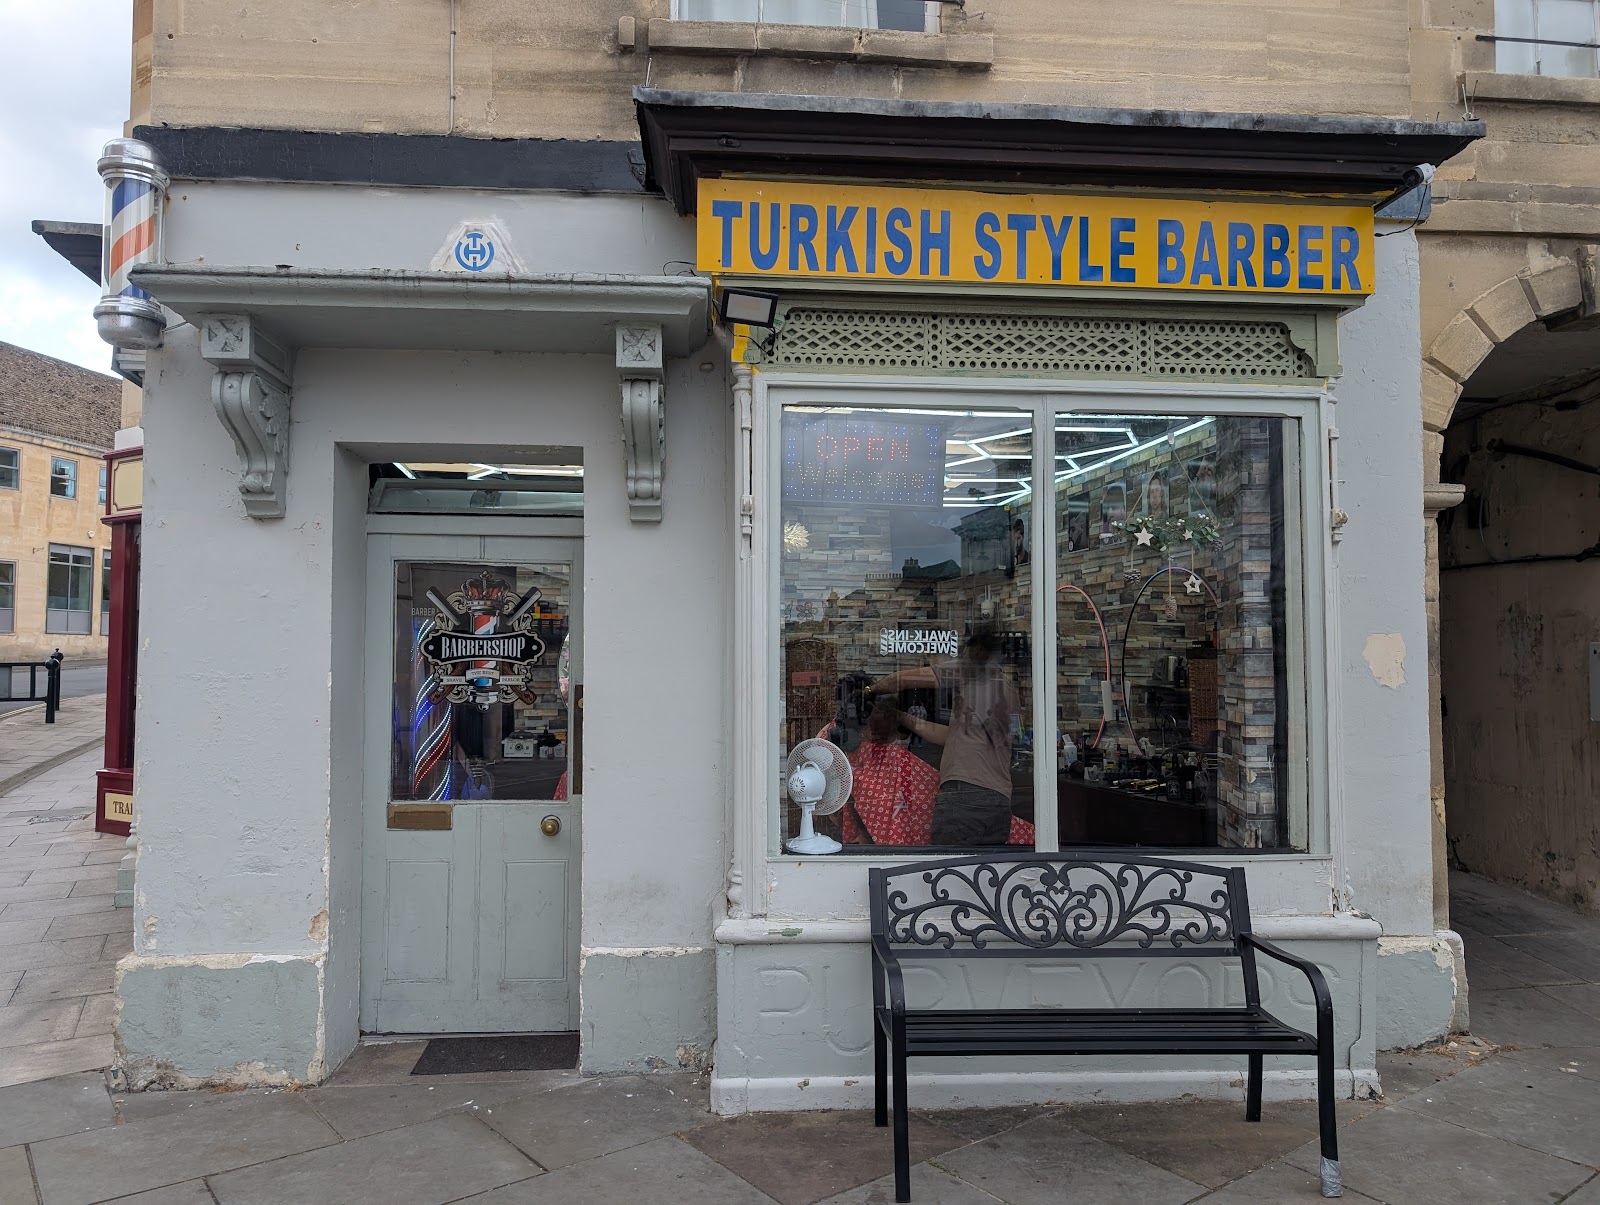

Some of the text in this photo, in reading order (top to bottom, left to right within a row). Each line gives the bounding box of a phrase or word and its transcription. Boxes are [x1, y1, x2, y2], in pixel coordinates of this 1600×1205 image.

[712, 199, 1362, 291] TURKISH STYLE BARBER
[817, 435, 910, 462] OPEN
[797, 462, 925, 489] Welcome
[441, 637, 526, 659] BARBERSHOP
